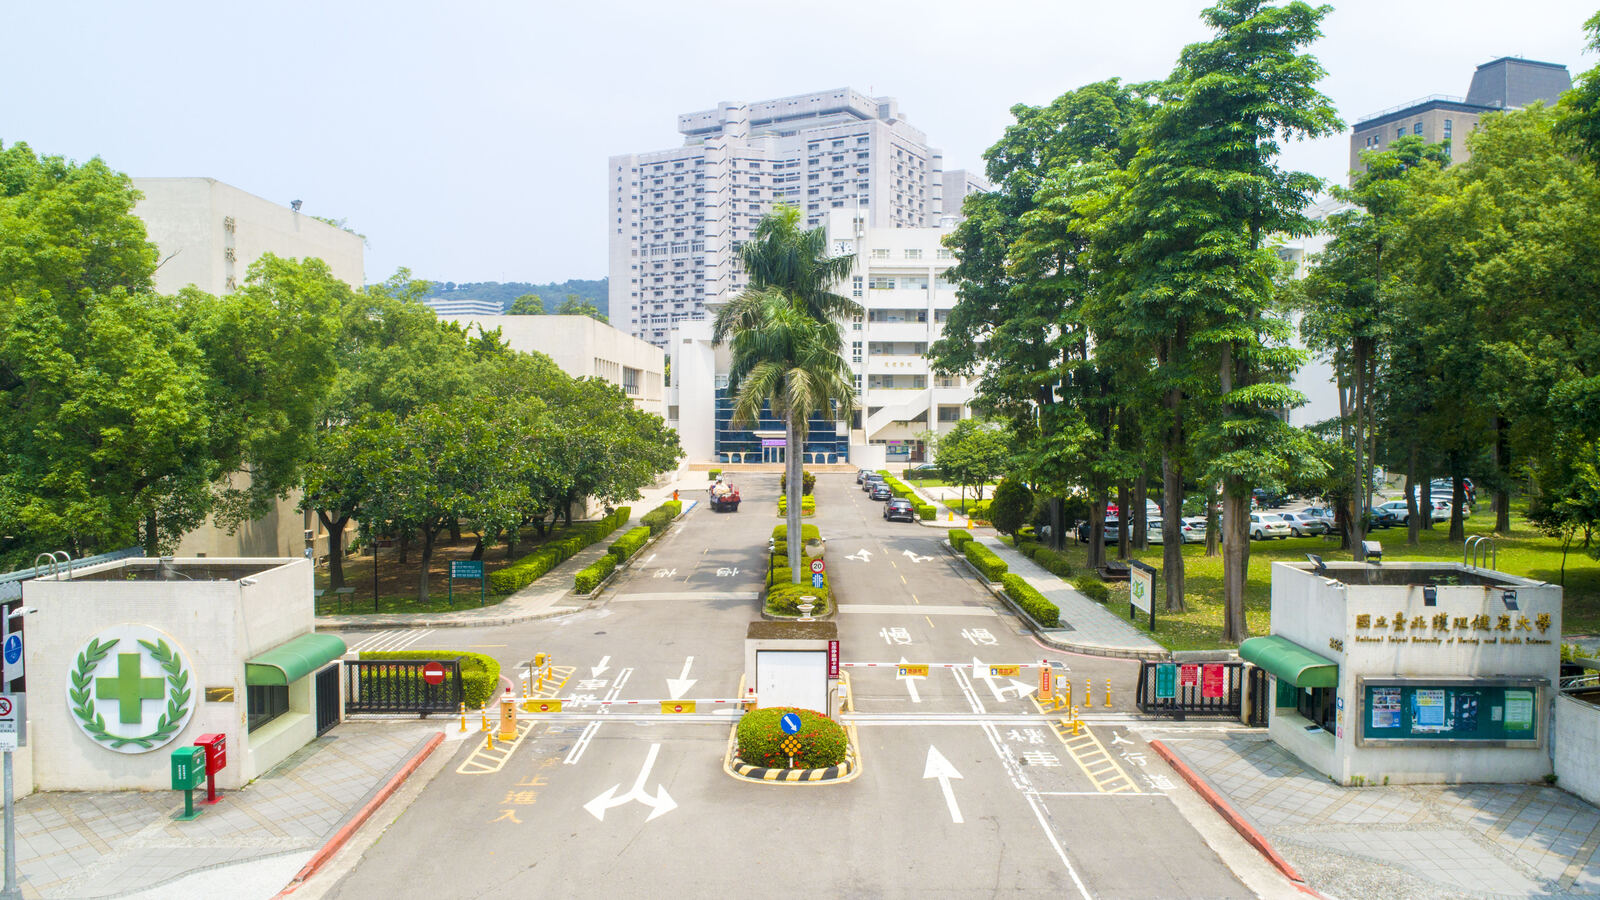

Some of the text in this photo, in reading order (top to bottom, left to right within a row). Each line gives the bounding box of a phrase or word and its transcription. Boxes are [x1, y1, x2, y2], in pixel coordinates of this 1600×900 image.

[1356, 611, 1551, 634] 國立臺北護理健康大學
[879, 627, 912, 645] 慢
[961, 628, 999, 645] 慢
